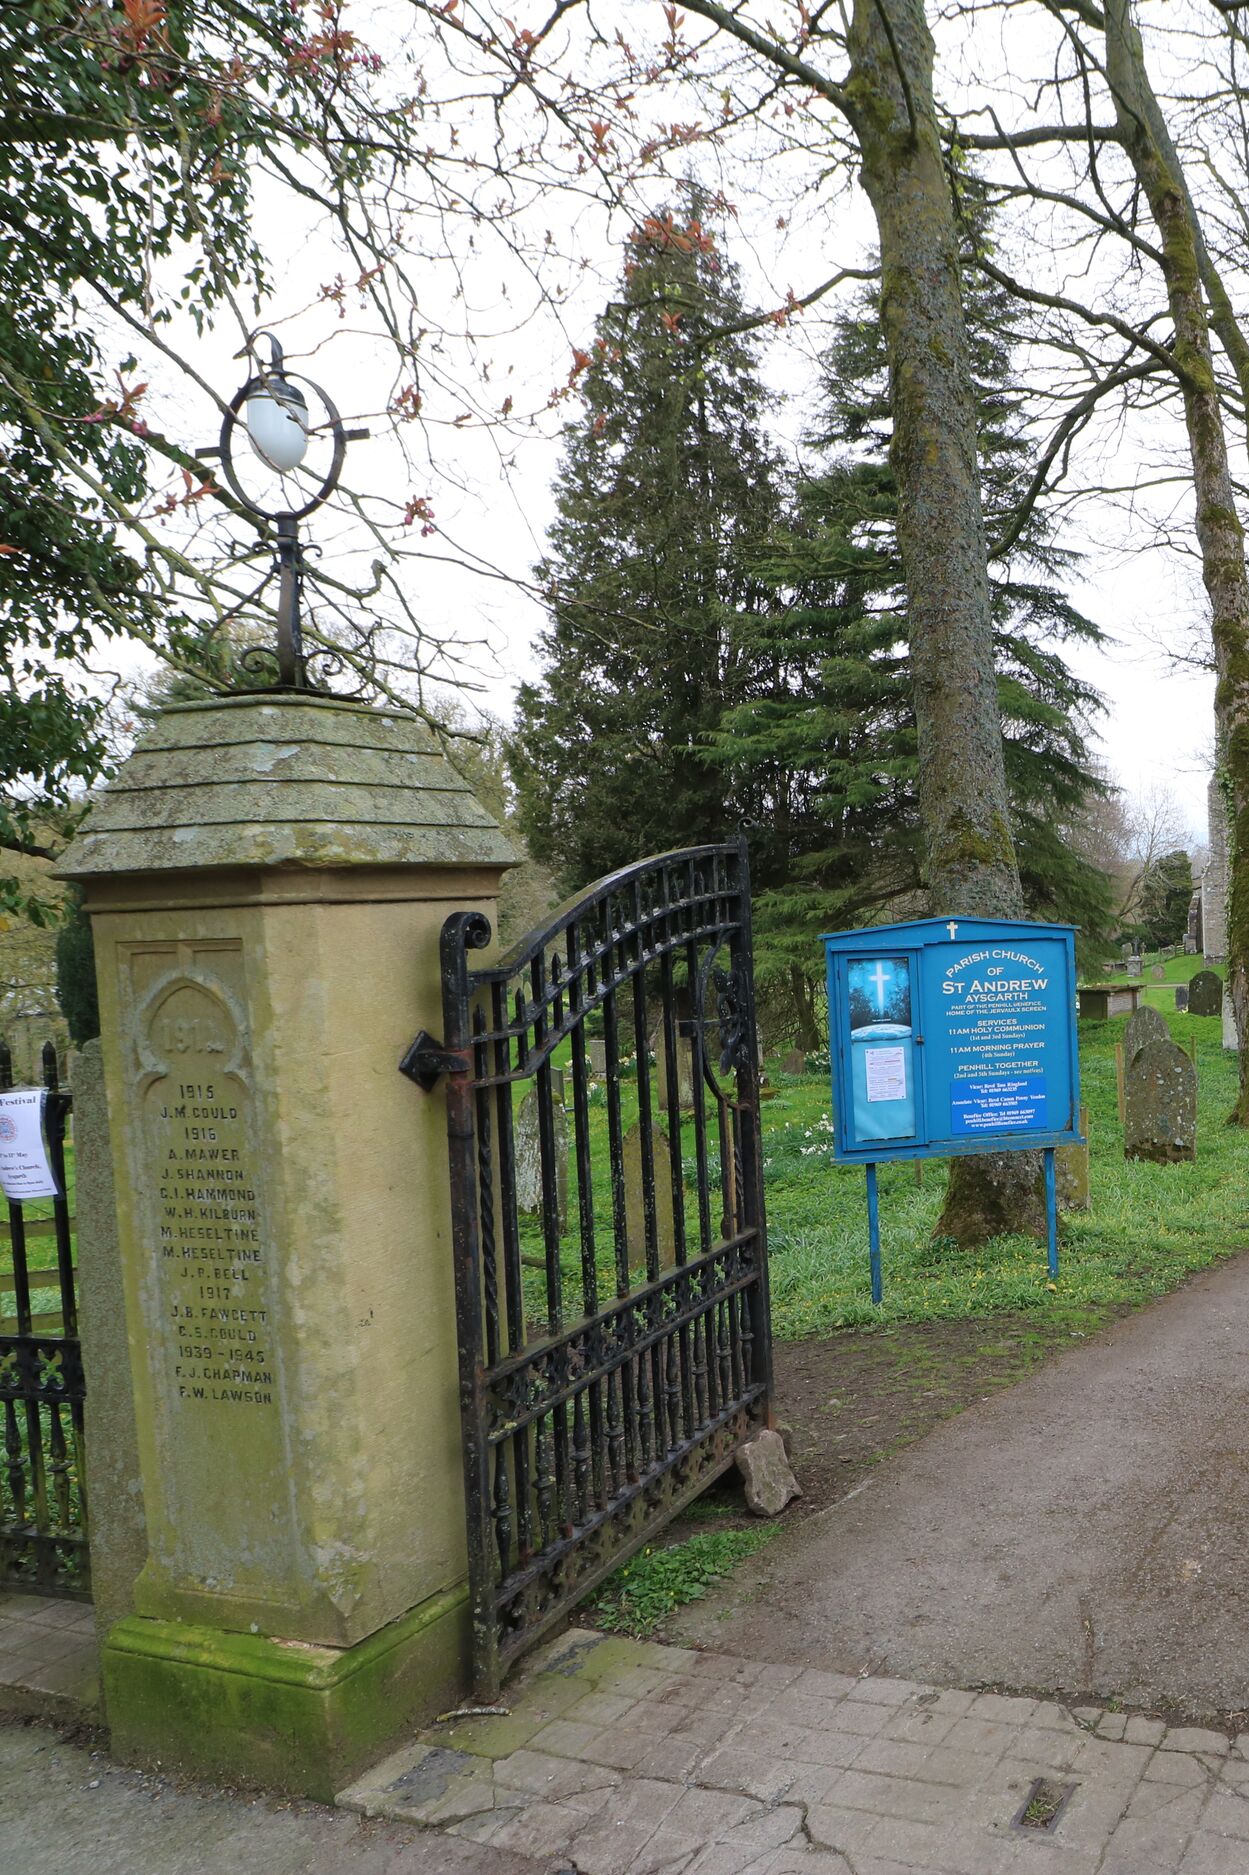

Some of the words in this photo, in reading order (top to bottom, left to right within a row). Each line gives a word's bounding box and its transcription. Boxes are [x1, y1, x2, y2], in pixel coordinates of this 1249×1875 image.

[945, 950, 990, 978] PARISH
[992, 949, 1044, 975] CHURCH
[987, 967, 1004, 976] OF
[965, 991, 1028, 1003] AYSGARTH
[977, 1018, 1017, 1027] SERVICES
[971, 1026, 992, 1034] HOLY
[994, 1023, 1045, 1033] COMMUNION
[973, 1044, 1011, 1052] MORNING
[1013, 1041, 1045, 1050] PRAYER
[995, 1060, 1039, 1069] TOGETHER
[180, 1085, 213, 1099] 1915
[185, 1127, 216, 1140] 1916
[200, 1286, 230, 1300] 1917
